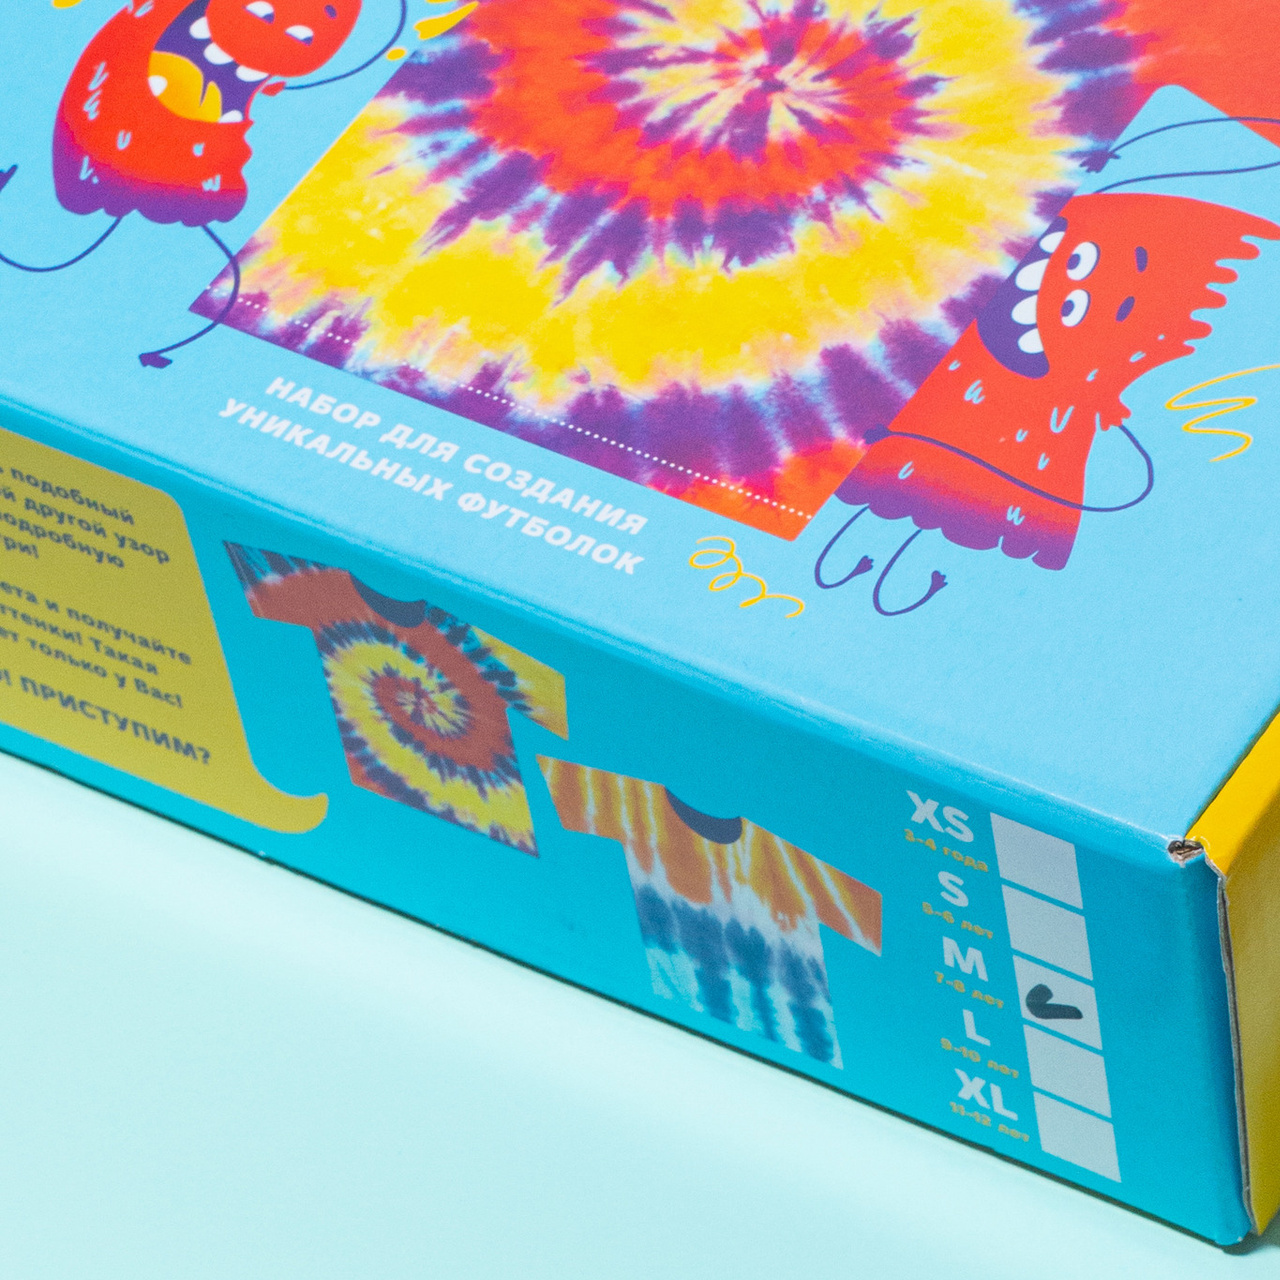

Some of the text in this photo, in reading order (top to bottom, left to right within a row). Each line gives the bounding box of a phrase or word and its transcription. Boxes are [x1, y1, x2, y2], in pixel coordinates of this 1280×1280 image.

[266, 377, 648, 535] НАБОР ДЛЯ СОЗДАНИЯ
[11, 467, 134, 525] подобный
[218, 398, 645, 575] УНИКАЛЬНЫХ ФУТБОЛОК
[0, 511, 125, 568] одробную
[25, 497, 107, 538] другой
[114, 532, 170, 564] узор
[45, 599, 59, 613] и
[67, 606, 192, 665] получайте
[88, 636, 158, 675] Такая
[26, 637, 107, 678] только
[114, 672, 126, 689] у
[134, 677, 183, 708] Вас!
[20, 675, 210, 765] ПРИСТУПИМ?
[906, 789, 974, 842] XS
[942, 847, 988, 872] года
[937, 870, 969, 907] S
[961, 920, 993, 940] лет
[942, 936, 989, 982] M
[971, 989, 1004, 1009] лет
[962, 1009, 991, 1047] L
[954, 1068, 1018, 1121] XL
[987, 1060, 1019, 1079] лет
[998, 1123, 1030, 1143] лет
